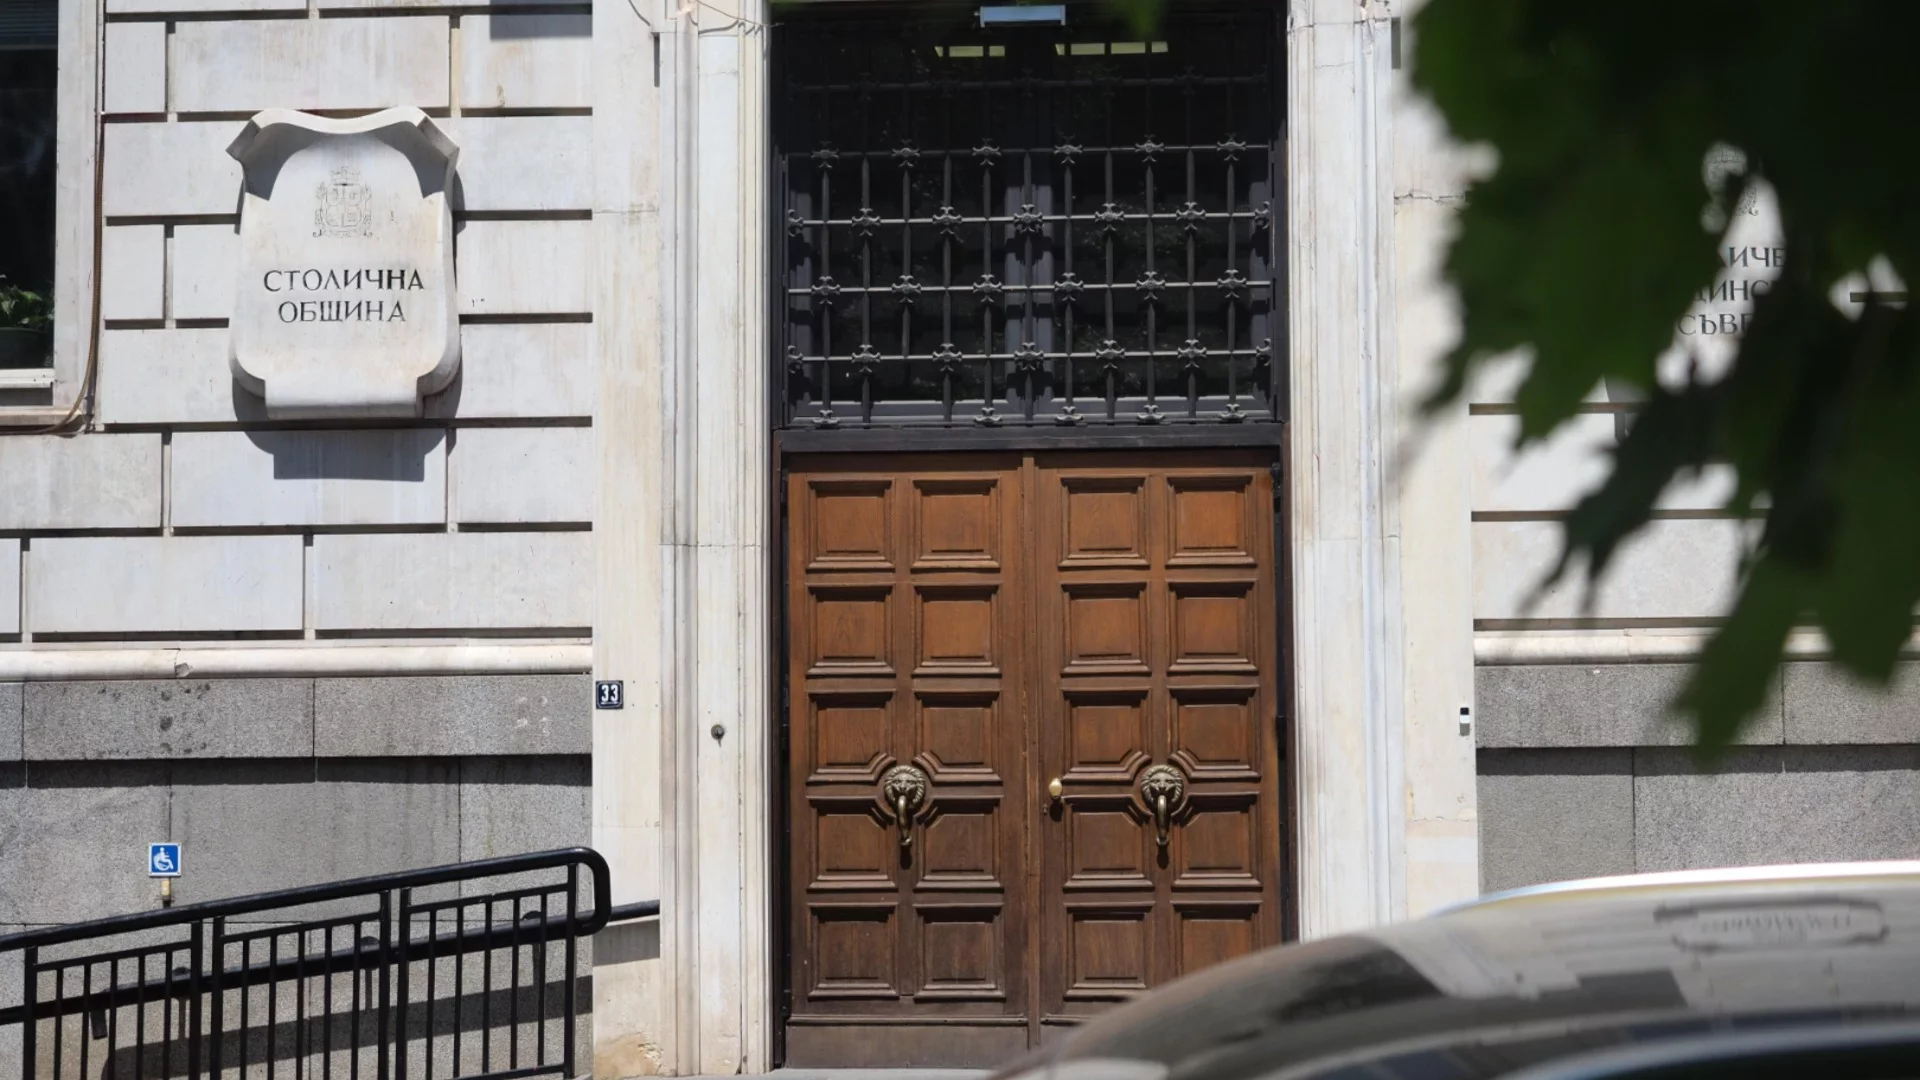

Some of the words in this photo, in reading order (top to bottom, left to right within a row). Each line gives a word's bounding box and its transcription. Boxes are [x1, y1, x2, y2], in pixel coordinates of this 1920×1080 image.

[263, 268, 425, 292] СТОЛИЧНА
[278, 300, 406, 323] ОБЩИНА
[601, 684, 619, 702] 33
